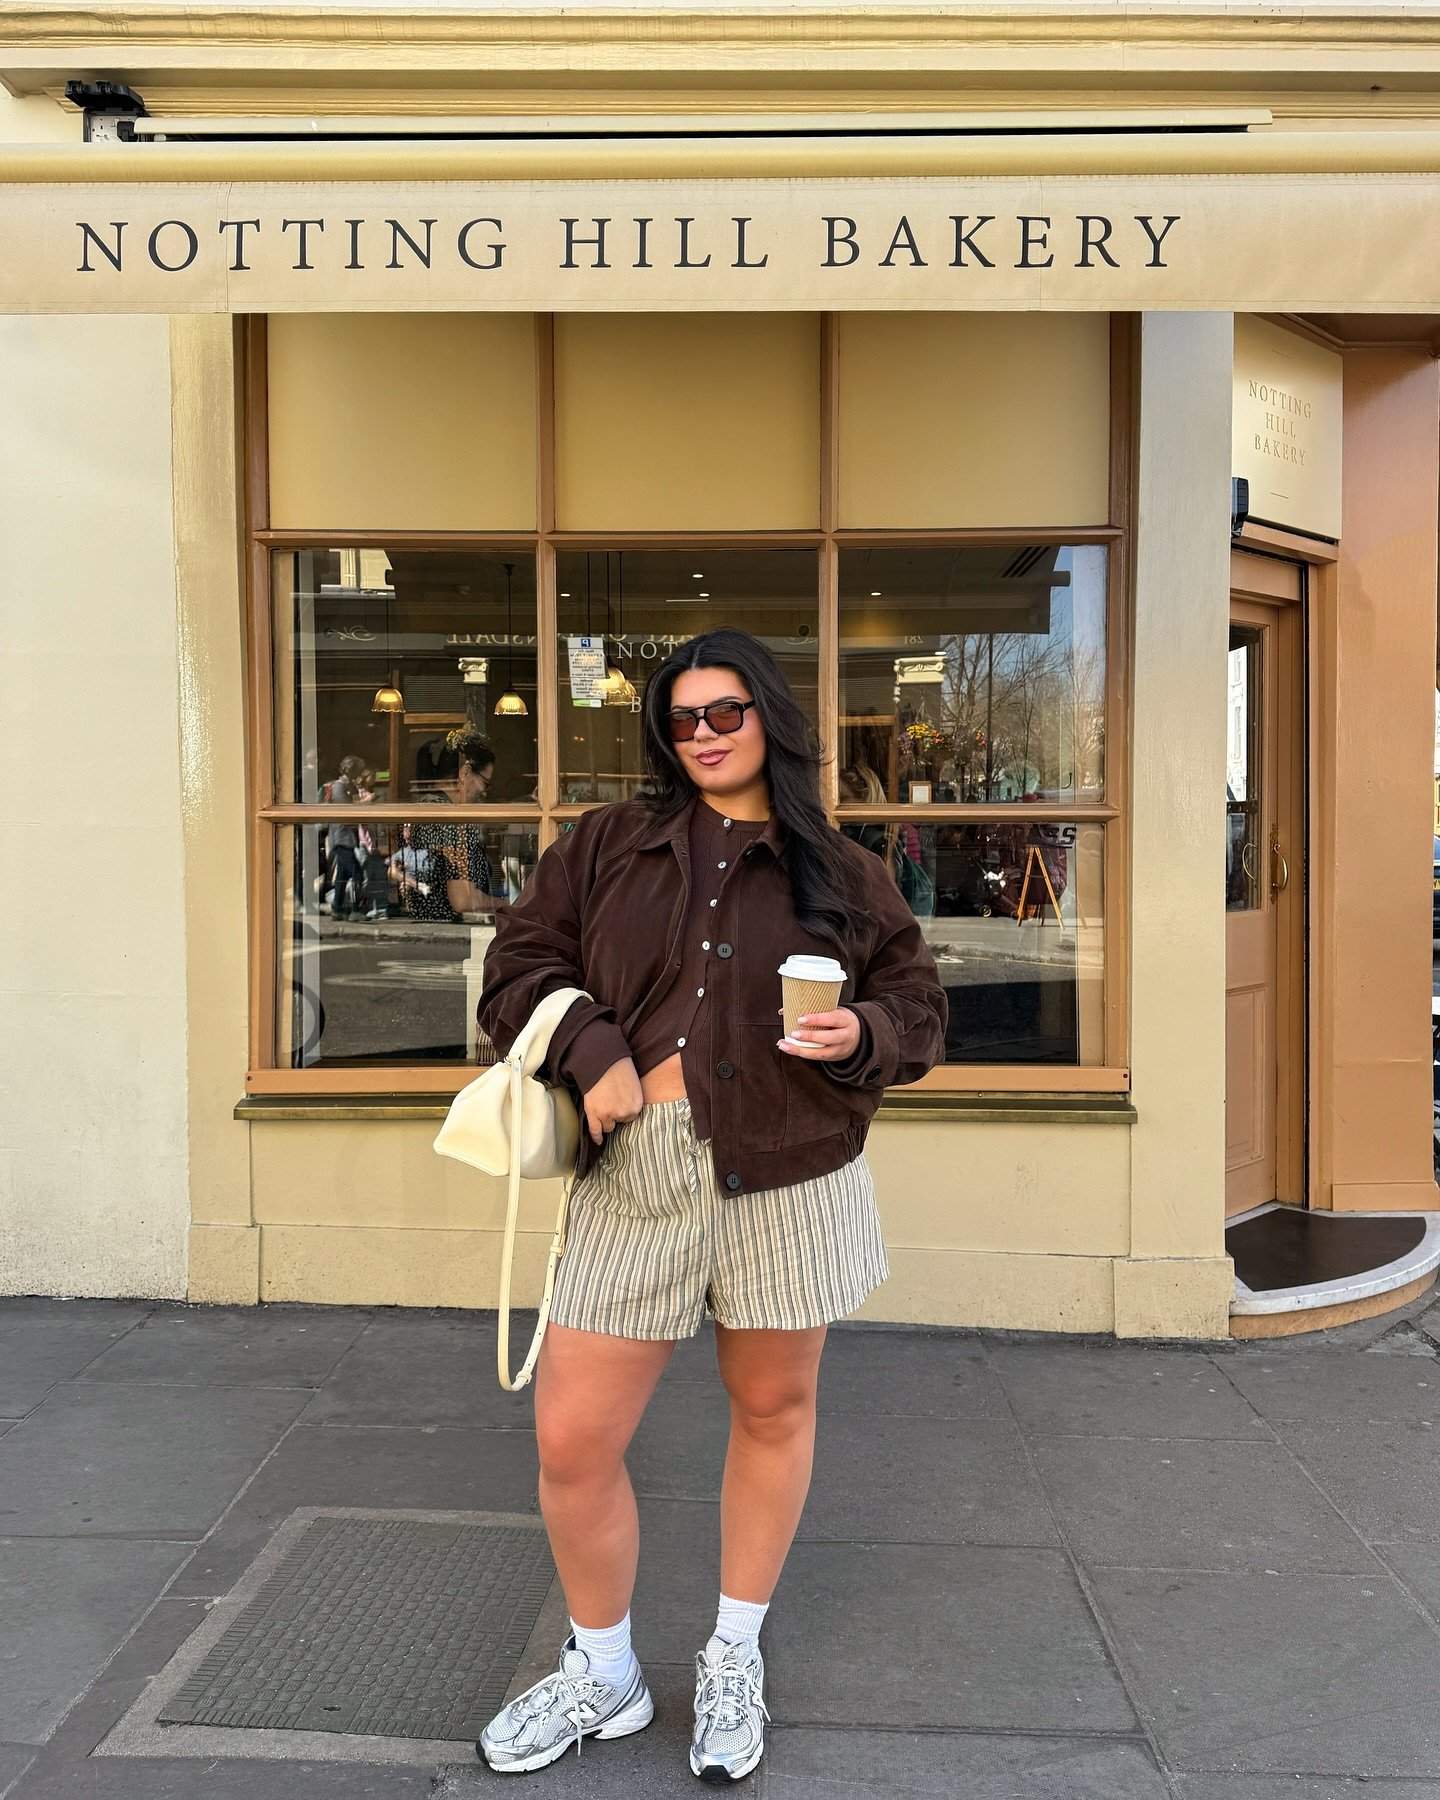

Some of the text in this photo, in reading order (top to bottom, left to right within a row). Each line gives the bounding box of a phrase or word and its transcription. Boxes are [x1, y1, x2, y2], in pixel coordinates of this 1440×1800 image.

[76, 214, 1182, 272] NOTTING HILL BAKERY
[1248, 380, 1311, 419] NOTTING
[1265, 411, 1296, 438] HILL
[1254, 433, 1305, 466] BAKERY
